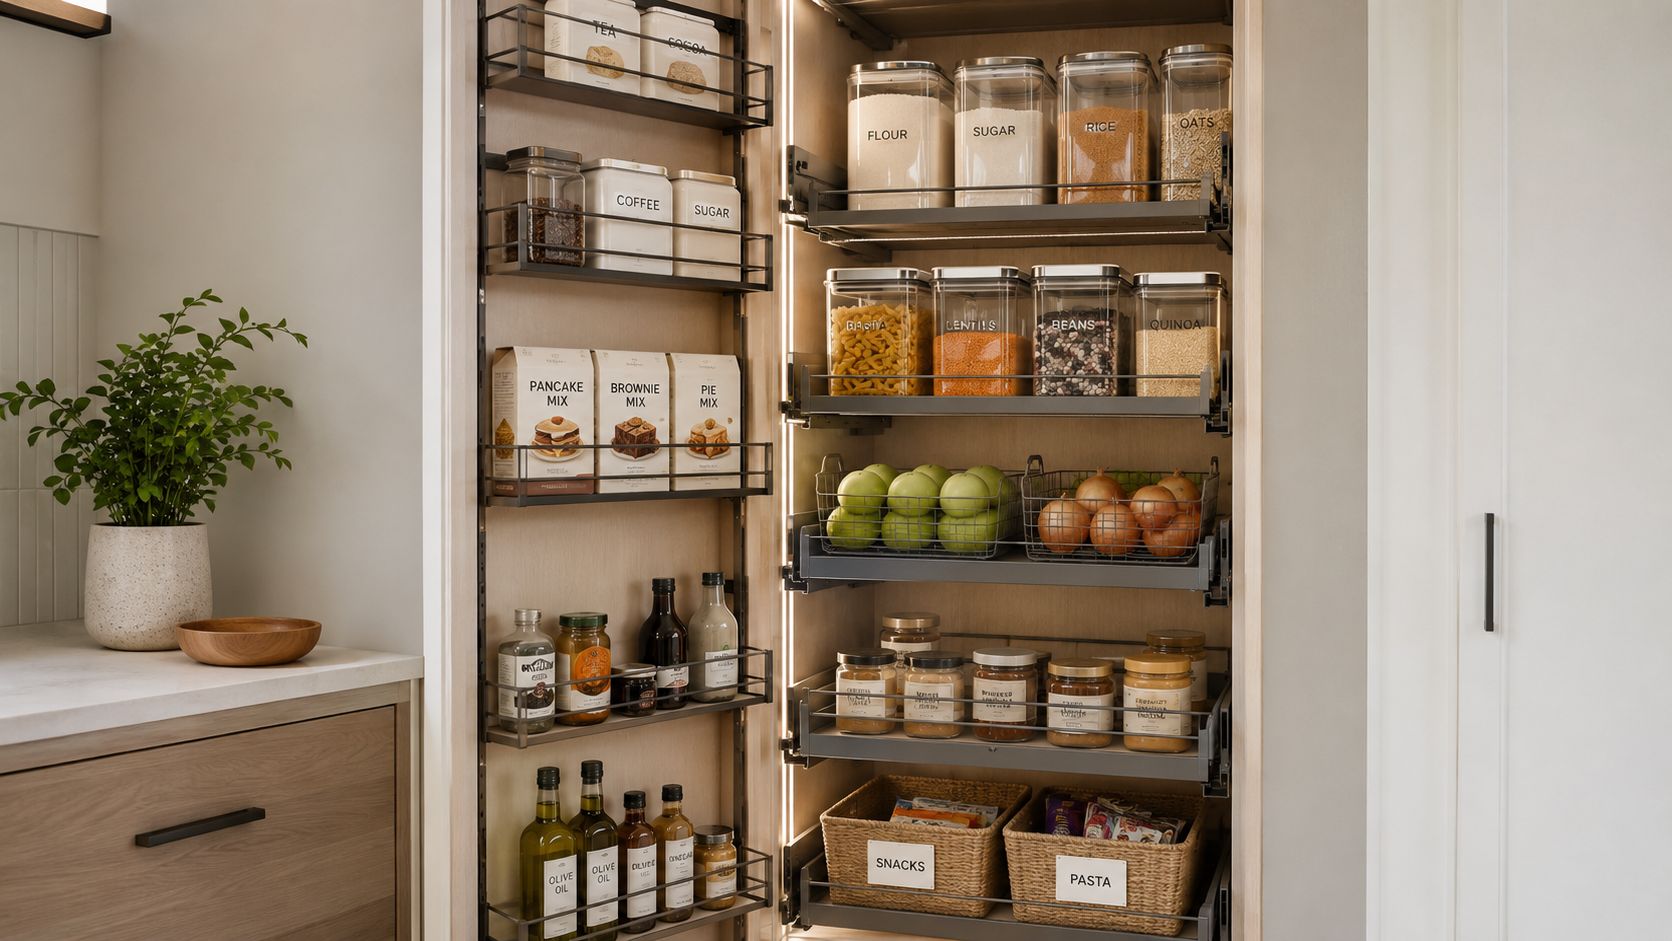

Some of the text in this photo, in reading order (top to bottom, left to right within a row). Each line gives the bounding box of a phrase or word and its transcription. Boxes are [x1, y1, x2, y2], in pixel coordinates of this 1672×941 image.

[592, 20, 617, 39] TEA
[668, 37, 708, 57] COCOA
[1085, 121, 1117, 133] RICE
[1180, 117, 1215, 130] OATS
[867, 129, 908, 141] FLOUR
[973, 125, 1016, 137] SUGAR
[616, 194, 660, 211] COFFEE
[694, 205, 730, 219] SUGAR
[1051, 319, 1096, 331] BEANS
[1150, 319, 1201, 331] QUINOA
[529, 380, 584, 393] PANCAKE
[610, 382, 660, 395] BROWNIE
[701, 384, 717, 396] PIE
[546, 395, 568, 407] MIX
[625, 396, 646, 408] MIX
[699, 397, 718, 409] MIX
[592, 862, 616, 875] OLIVE
[876, 857, 926, 872] SNACKS
[548, 871, 574, 885] OLIVE
[597, 874, 610, 884] OIL
[1070, 873, 1112, 888] PASTA
[554, 884, 569, 895] OIL
